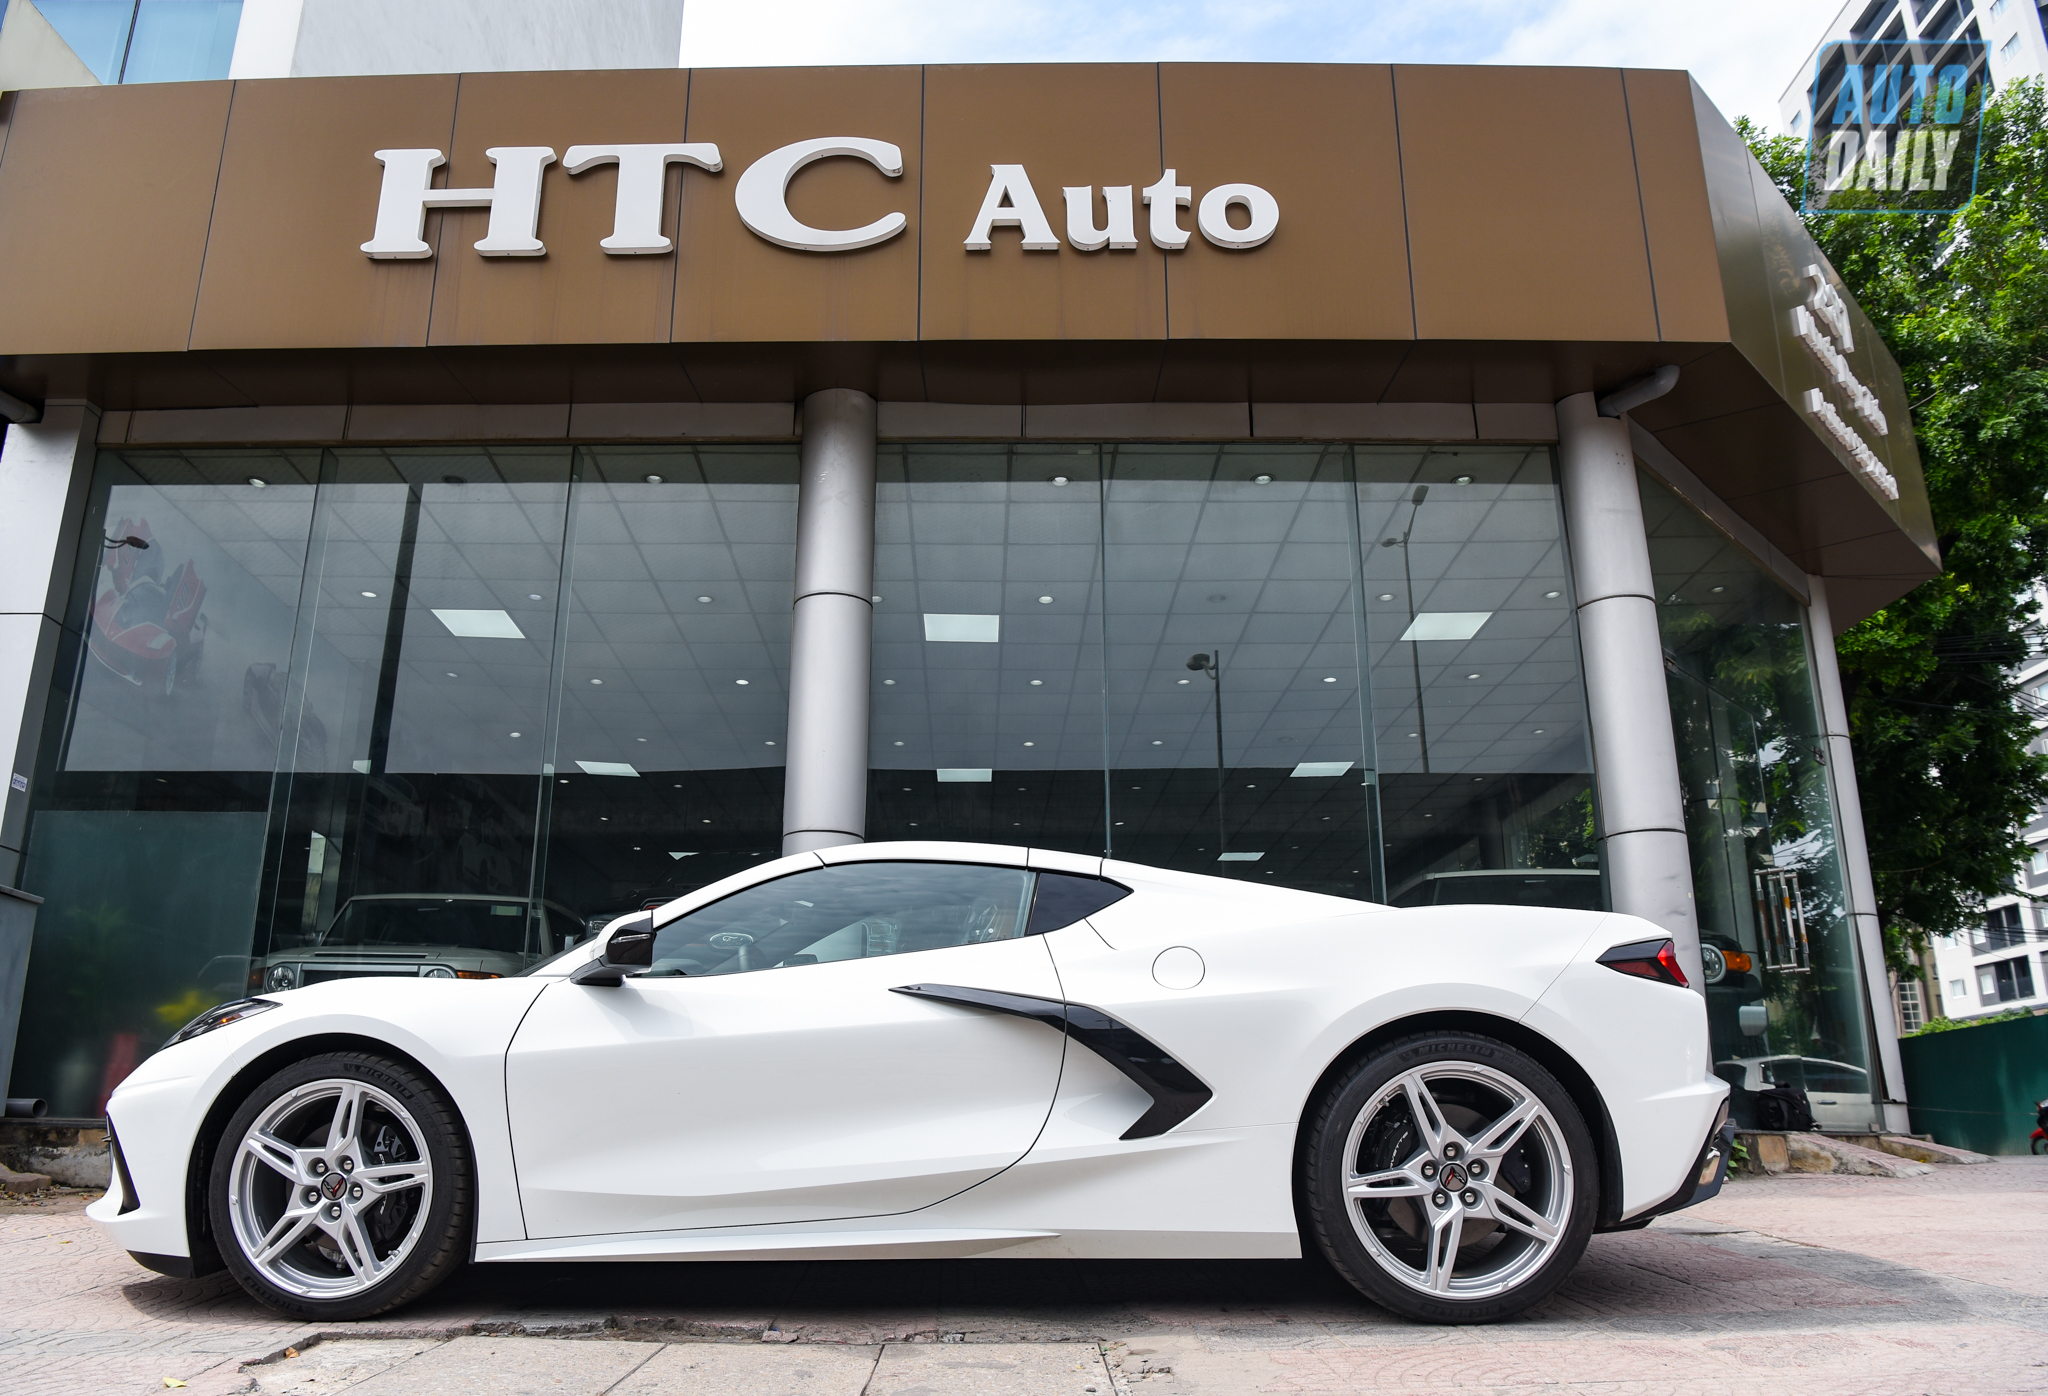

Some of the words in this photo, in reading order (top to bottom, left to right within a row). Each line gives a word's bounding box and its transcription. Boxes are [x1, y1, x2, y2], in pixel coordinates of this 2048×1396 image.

[360, 136, 907, 260] HTC
[963, 164, 1280, 251] Auto
[1417, 1043, 1491, 1057] MICHELIN
[359, 1066, 412, 1098] MICHELIN
